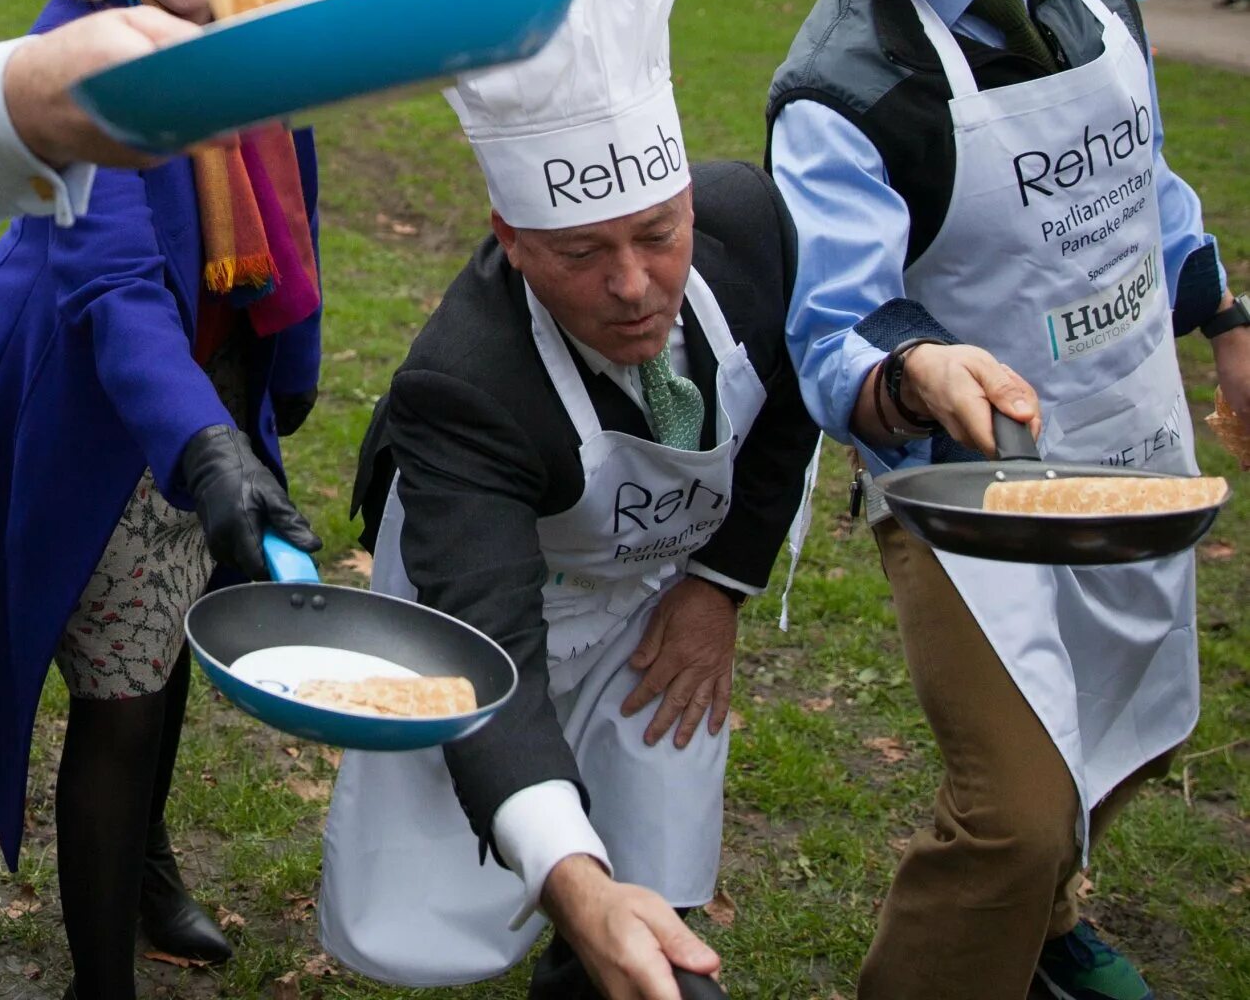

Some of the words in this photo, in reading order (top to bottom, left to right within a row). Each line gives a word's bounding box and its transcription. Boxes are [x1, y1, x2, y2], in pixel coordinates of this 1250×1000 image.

[543, 125, 681, 207] Rehab
[1013, 96, 1151, 207] Rehab
[1041, 164, 1153, 242] Parliamentary
[1061, 217, 1121, 257] Pancake
[1121, 197, 1146, 223] Race
[1061, 253, 1154, 342] Hudgell
[1088, 250, 1129, 281] Sponsored
[1130, 243, 1140, 253] by
[1068, 320, 1131, 355] SOLICITORS
